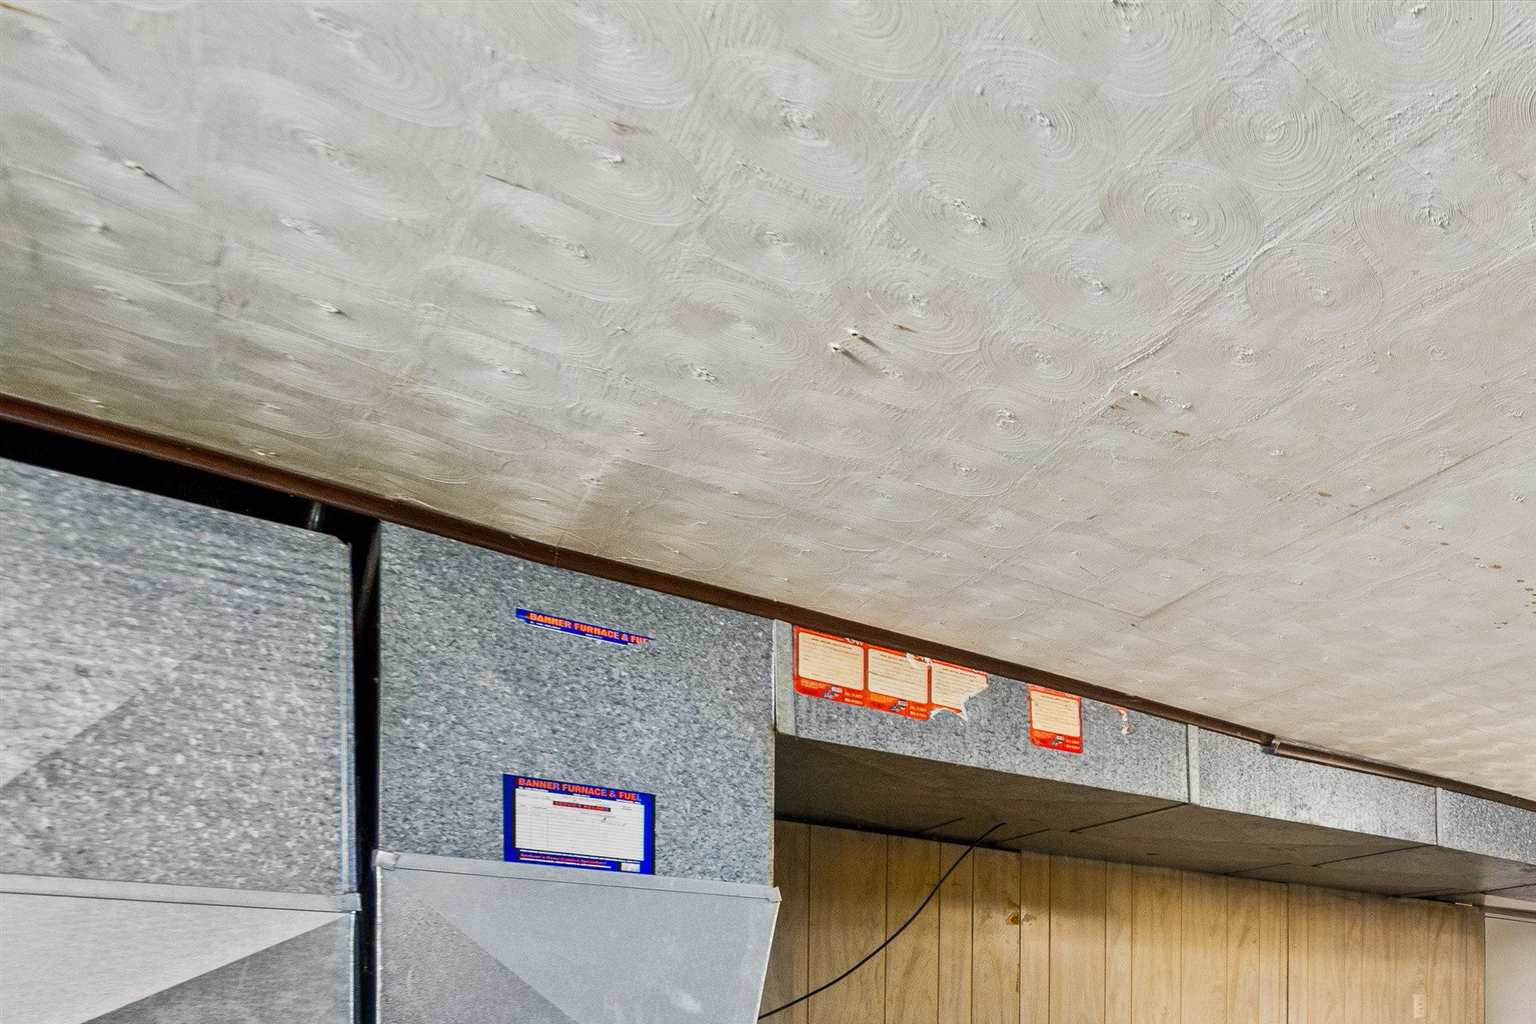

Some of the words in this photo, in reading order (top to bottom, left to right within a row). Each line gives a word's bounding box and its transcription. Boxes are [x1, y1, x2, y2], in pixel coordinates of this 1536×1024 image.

[527, 612, 572, 629] BANNER
[573, 622, 620, 639] FURNACE
[620, 632, 629, 642] &
[518, 777, 561, 791] BANNER
[561, 783, 607, 797] FURNACE
[608, 789, 617, 798] &
[619, 791, 641, 801] FUEL
